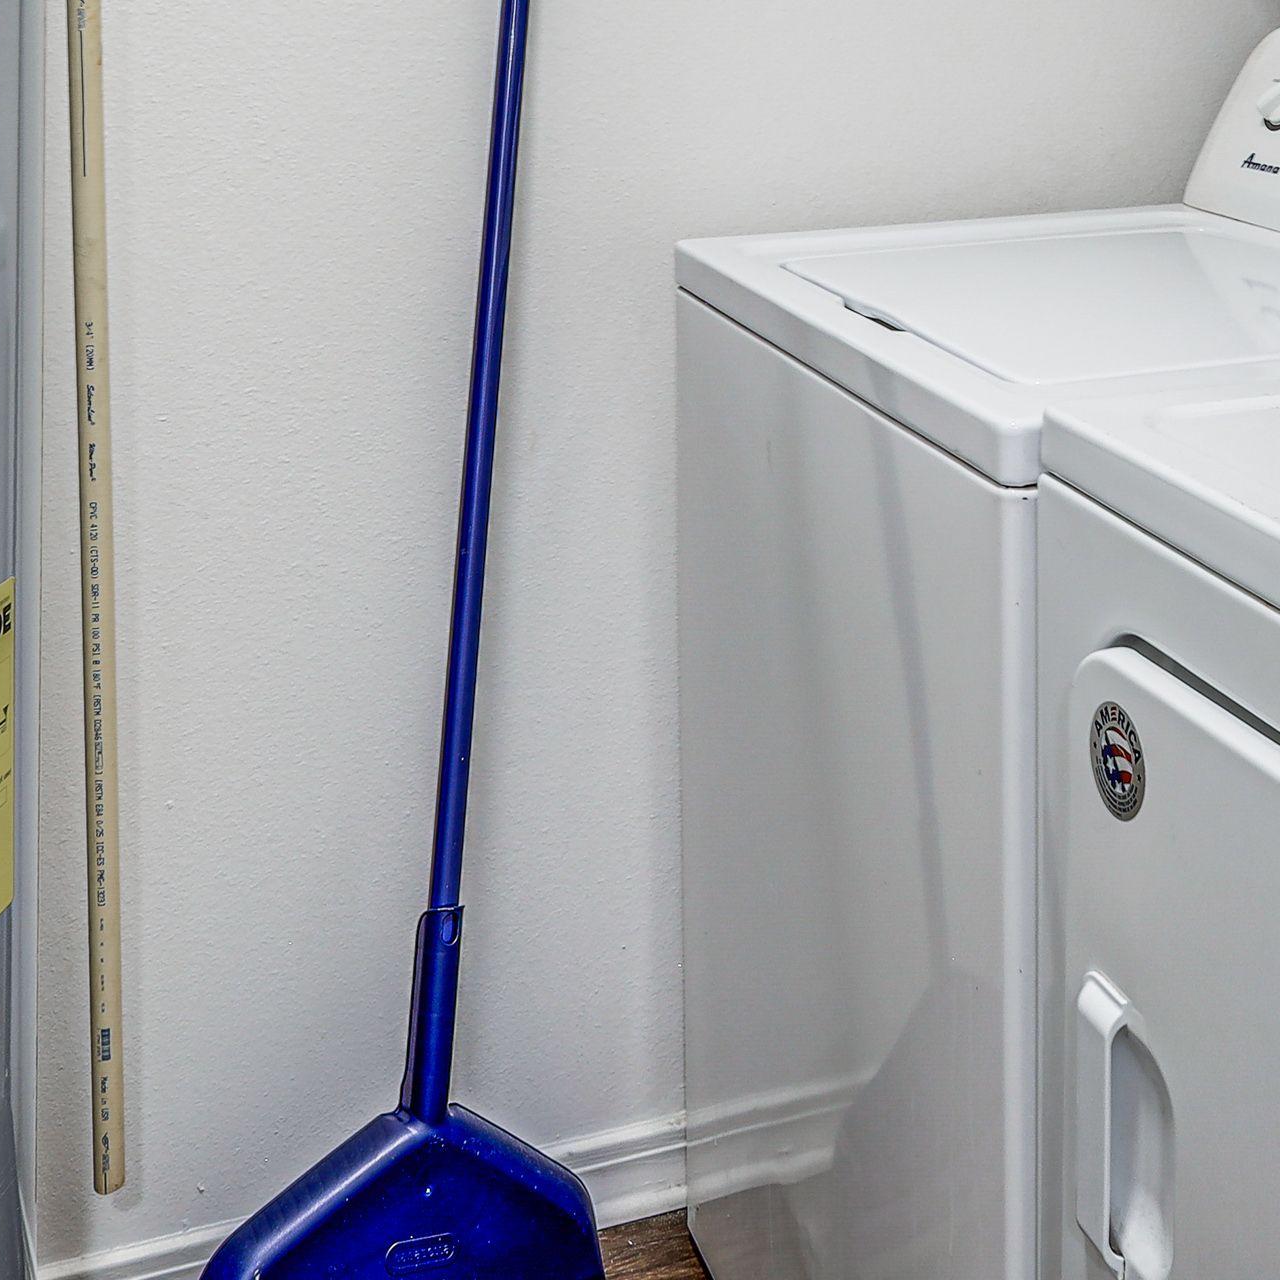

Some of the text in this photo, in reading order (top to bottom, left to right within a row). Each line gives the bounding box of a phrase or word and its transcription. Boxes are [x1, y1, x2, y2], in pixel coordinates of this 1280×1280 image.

[1241, 153, 1280, 174] Amana
[89, 501, 98, 519] CPVC
[89, 524, 99, 541] 4120
[91, 583, 100, 608] SDR-11
[91, 613, 100, 623] PR
[92, 627, 101, 639] 100
[92, 643, 101, 656] PSI
[1094, 705, 1142, 766] AMERICA
[95, 804, 105, 817] E84
[100, 1076, 109, 1094] Made
[100, 1108, 110, 1121] USA
